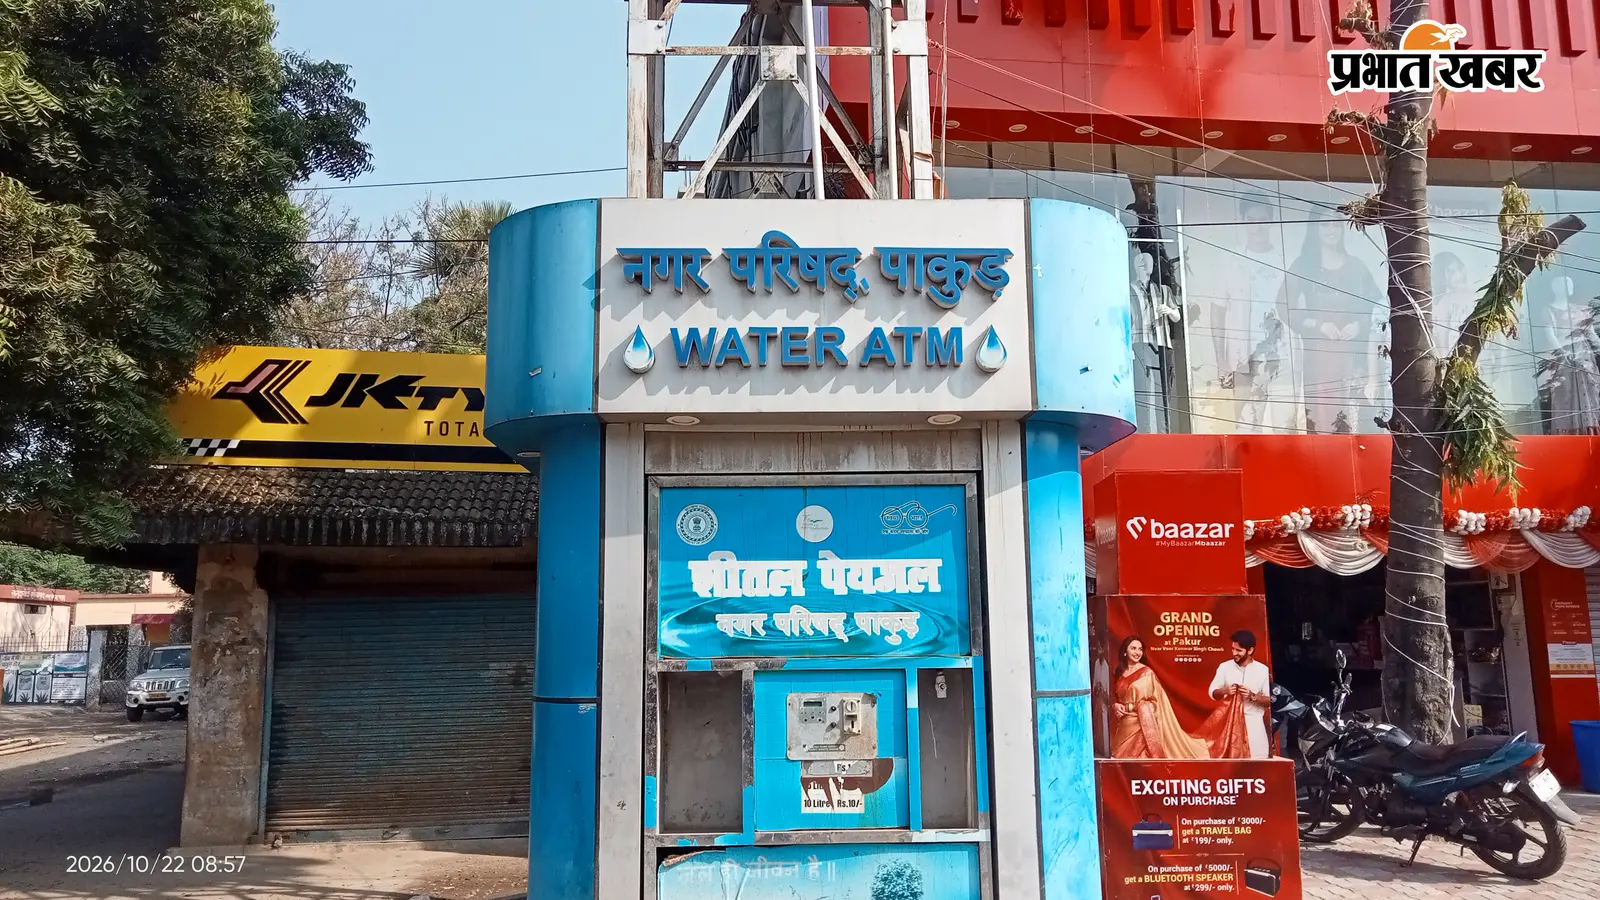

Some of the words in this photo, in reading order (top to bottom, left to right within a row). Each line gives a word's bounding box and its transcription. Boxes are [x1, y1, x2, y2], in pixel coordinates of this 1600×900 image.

[616, 247, 712, 294] नगर
[873, 247, 1014, 309] पाकुड़
[670, 326, 848, 368] WATER
[860, 326, 963, 368] ATM
[1160, 611, 1213, 624] GRAND
[715, 613, 768, 638] नगर
[773, 605, 849, 643] परिषद्
[1153, 624, 1220, 637] OPENING
[1172, 637, 1202, 646] Pakur
[1131, 779, 1211, 795] EXCITING
[1216, 778, 1266, 794] GIFTS
[804, 800, 812, 808] 10
[813, 799, 831, 808] Litre
[836, 799, 863, 808] Rs.10/-
[1162, 796, 1179, 806] ON
[1193, 817, 1226, 828] purchase
[1227, 817, 1236, 825] of
[1181, 829, 1193, 837] get
[1201, 826, 1232, 835] TRAVEL
[1234, 826, 1252, 835] BAG
[1216, 836, 1234, 845] only.
[1147, 865, 1159, 873] On
[1160, 864, 1193, 875] purchase
[1194, 863, 1203, 872] of
[1124, 876, 1137, 885] get
[1144, 874, 1194, 882] BLUETOOTH
[1195, 873, 1234, 881] SPEAKER
[1217, 883, 1235, 893] only.
